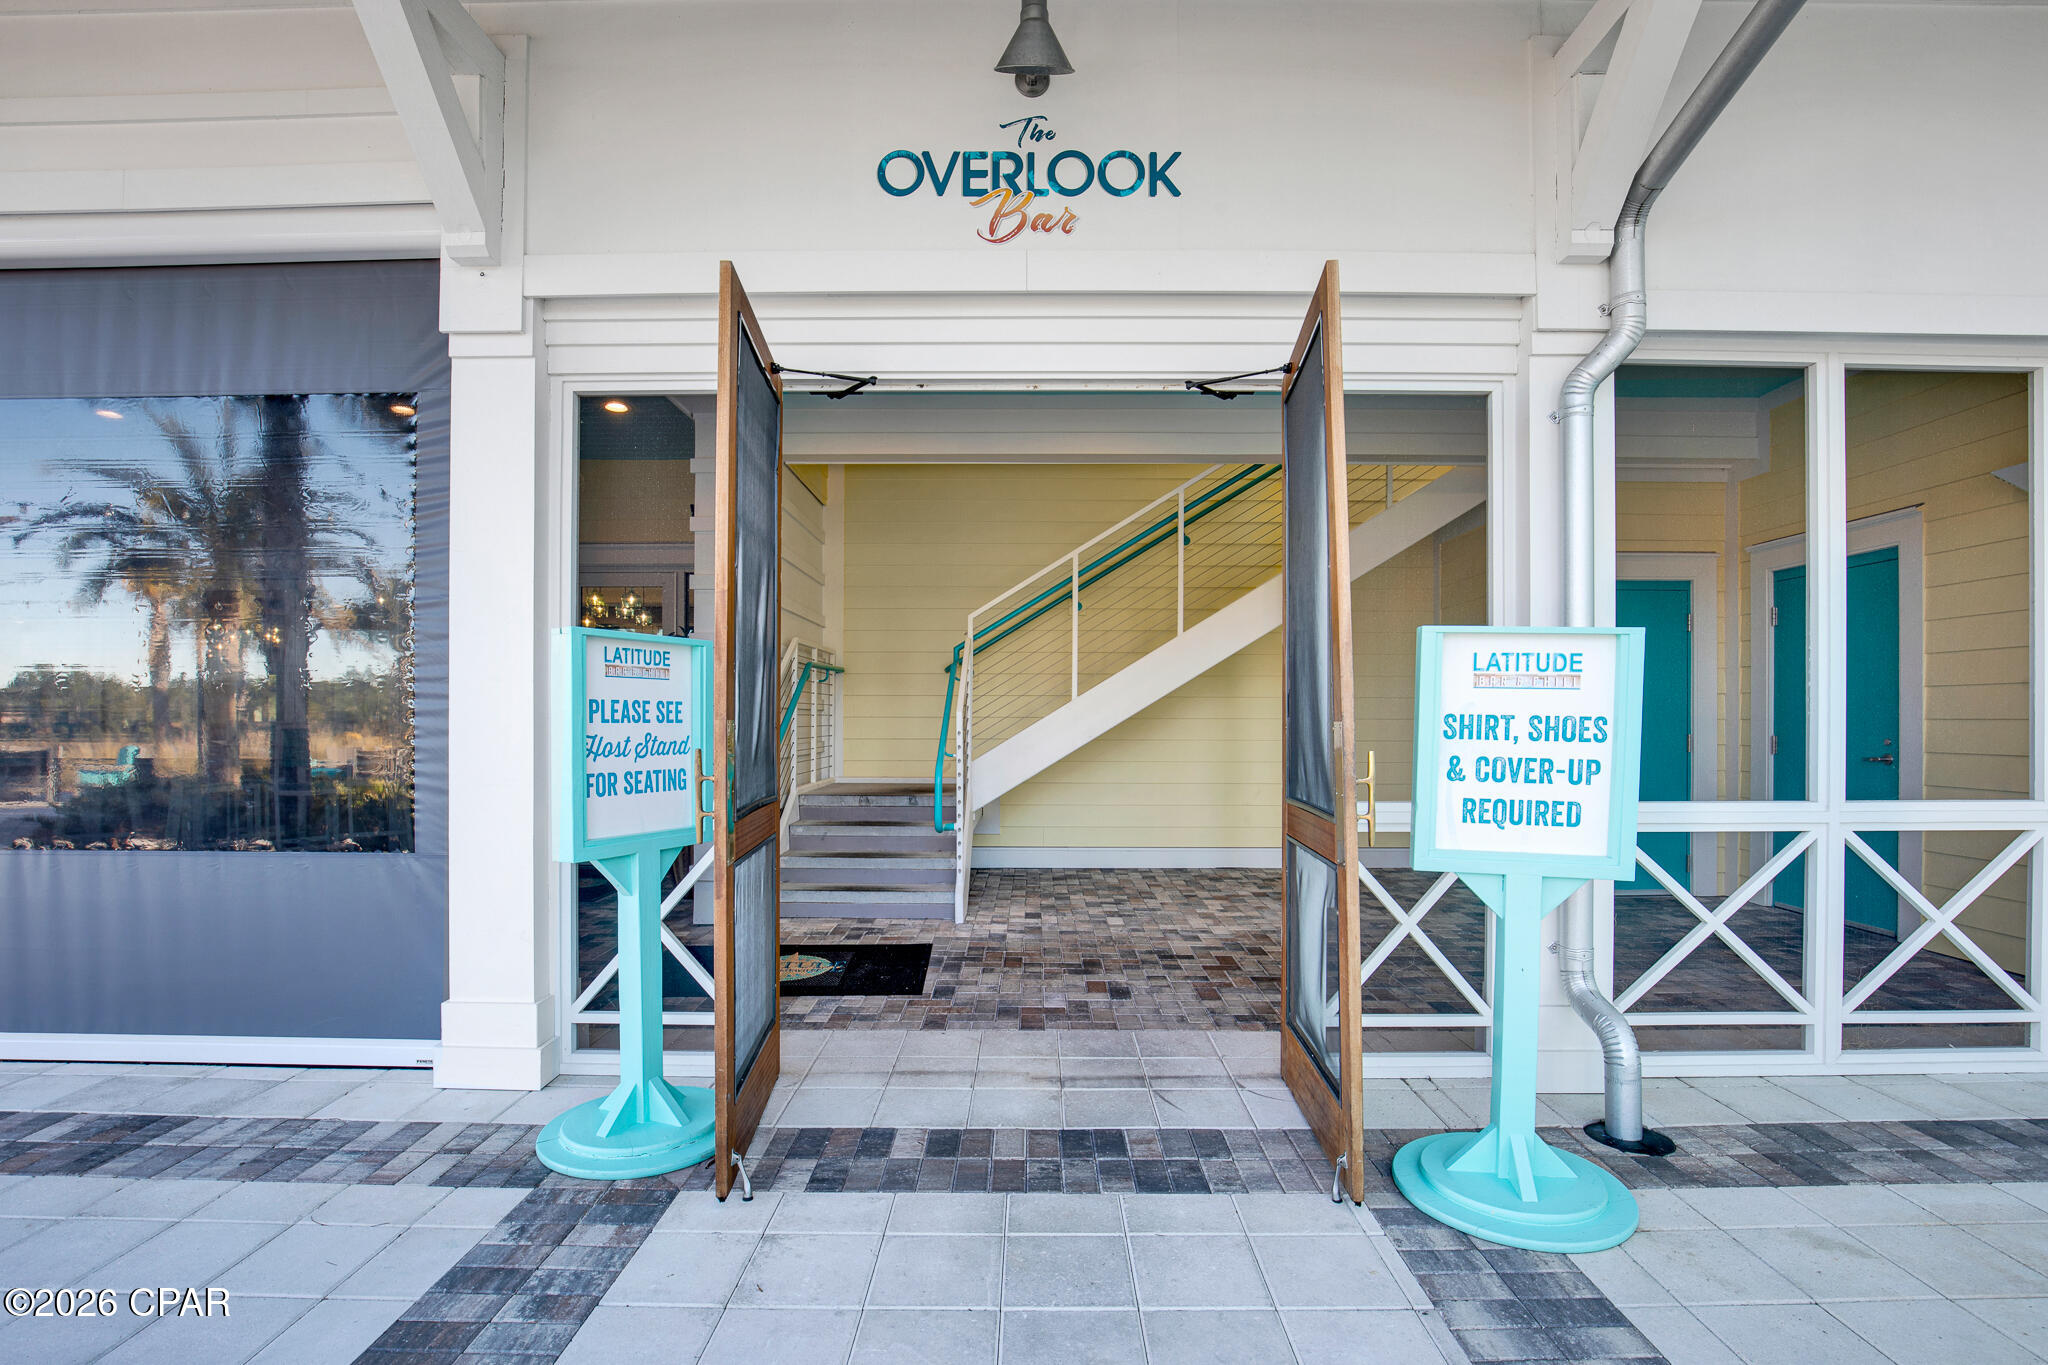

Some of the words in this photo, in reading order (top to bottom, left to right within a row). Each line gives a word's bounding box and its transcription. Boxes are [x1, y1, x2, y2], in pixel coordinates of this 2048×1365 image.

[999, 115, 1057, 148] The
[877, 150, 1182, 197] OVERLOOK
[969, 187, 1079, 244] Bar
[604, 646, 671, 667] LATITUDE
[1472, 652, 1584, 672] LATITUDE
[588, 699, 651, 724] PLEASE
[656, 700, 684, 724] SEE
[1442, 713, 1519, 744] SHIRT,
[1528, 715, 1608, 743] SHOES
[586, 734, 632, 763] Host
[634, 732, 691, 763] Stand
[586, 772, 618, 799] FOR
[624, 768, 688, 796] SEATING
[1446, 755, 1466, 782] &
[1475, 756, 1601, 786] COVER-UP
[1462, 798, 1583, 830] REQUIRED
